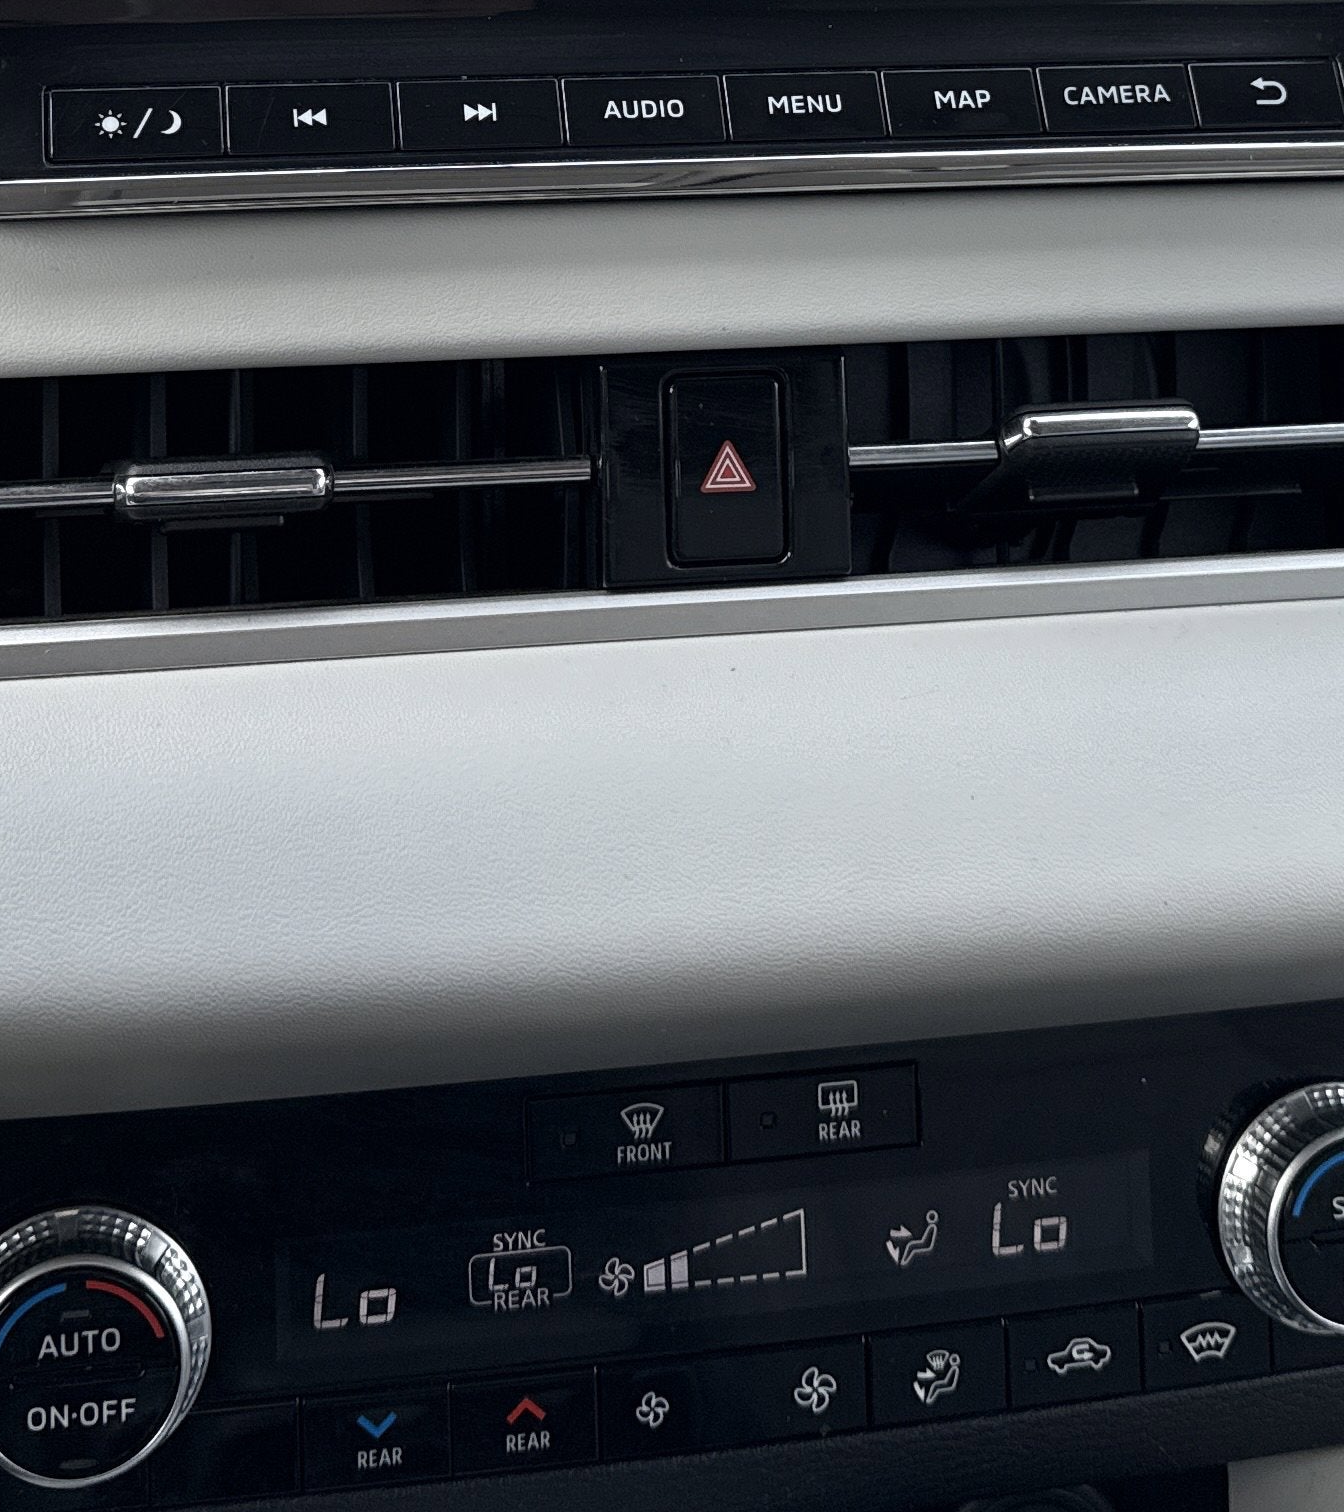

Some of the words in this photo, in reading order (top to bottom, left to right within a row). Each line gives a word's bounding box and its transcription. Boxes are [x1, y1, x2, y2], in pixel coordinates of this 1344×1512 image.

[767, 93, 842, 115] MENU
[934, 88, 991, 110] MAP
[1063, 84, 1171, 105] CAMERA
[604, 99, 684, 119] AUDIO
[818, 1119, 861, 1141] REAR
[617, 1141, 672, 1164] FRONT
[1007, 1175, 1058, 1199] SYNC
[493, 1228, 546, 1252] SYNC
[992, 1201, 1067, 1256] Lo
[488, 1257, 537, 1291] Lo
[313, 1273, 397, 1329] Lo
[494, 1287, 550, 1312] REAR
[38, 1327, 121, 1359] AUTO
[506, 1432, 550, 1452] REAR
[357, 1447, 403, 1468] REAR
